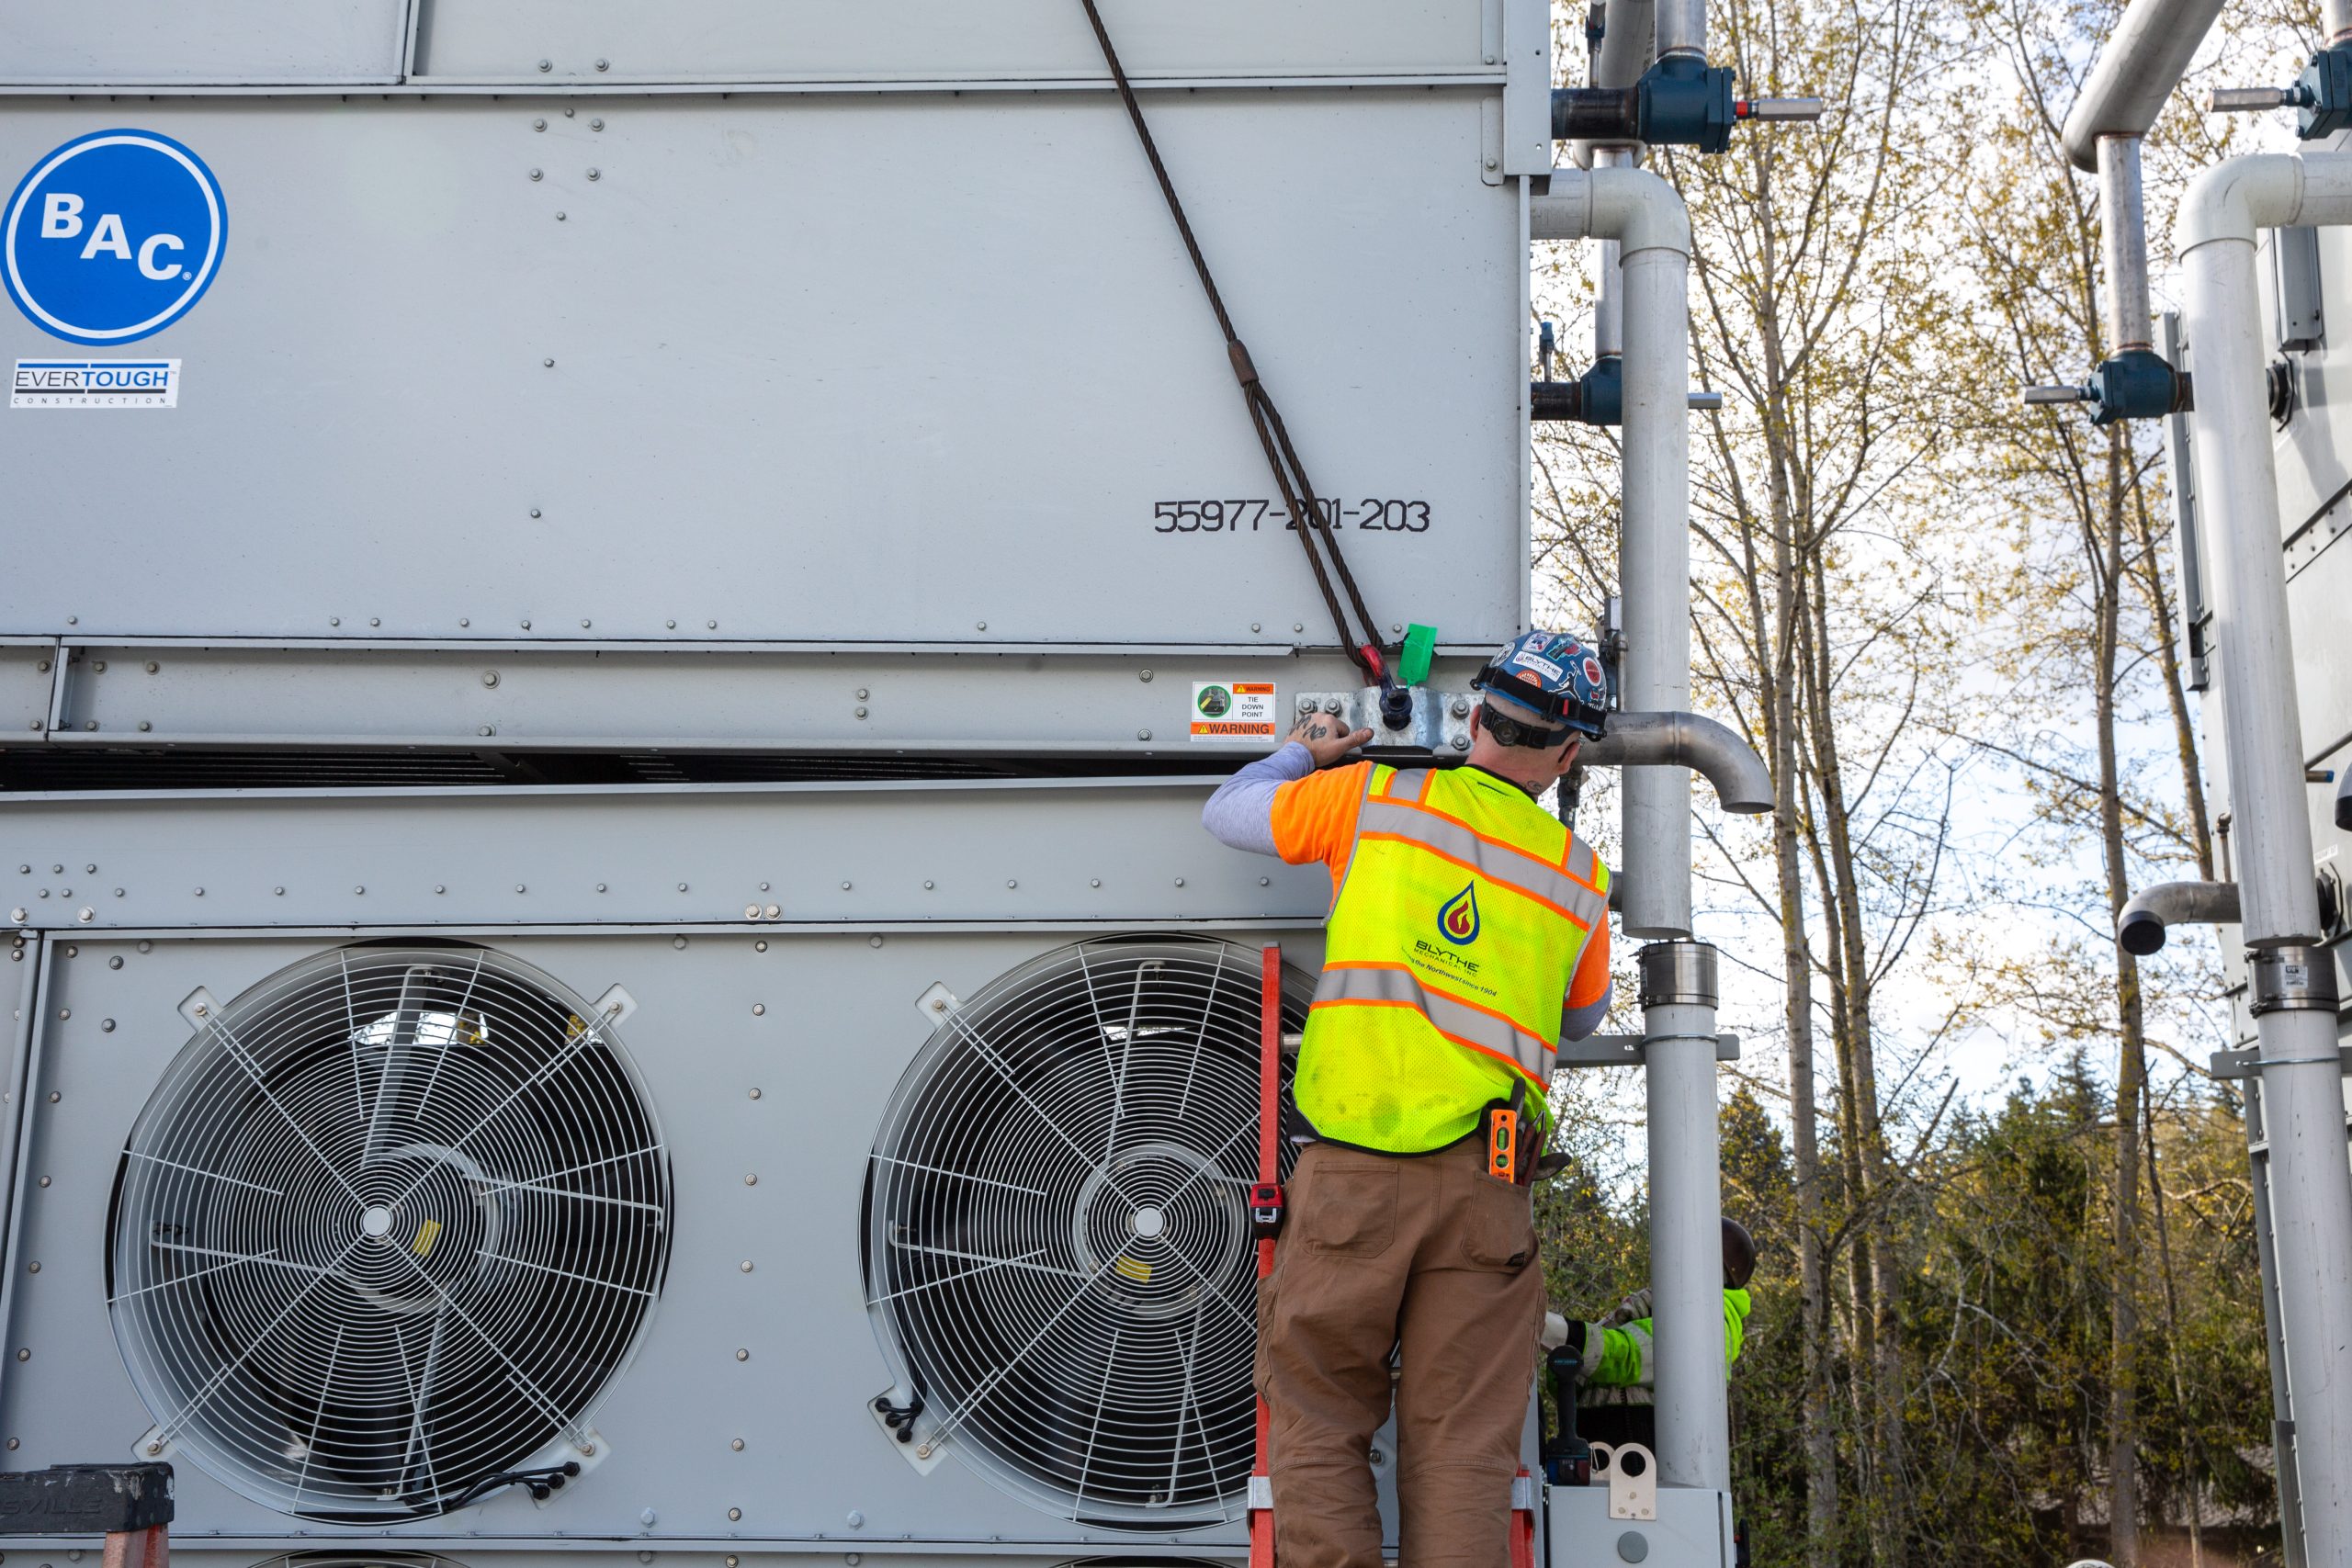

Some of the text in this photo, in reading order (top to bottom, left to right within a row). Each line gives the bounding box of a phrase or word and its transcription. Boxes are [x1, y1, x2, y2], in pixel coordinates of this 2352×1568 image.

[15, 370, 169, 388] EVERTOUGH
[13, 397, 167, 405] CONSTRUCTION
[1208, 723, 1270, 735] WARNING
[1415, 940, 1480, 973] BLYTHE
[1426, 964, 1463, 983] Northwest
[1462, 979, 1478, 990] since
[1480, 986, 1498, 997] 1904
